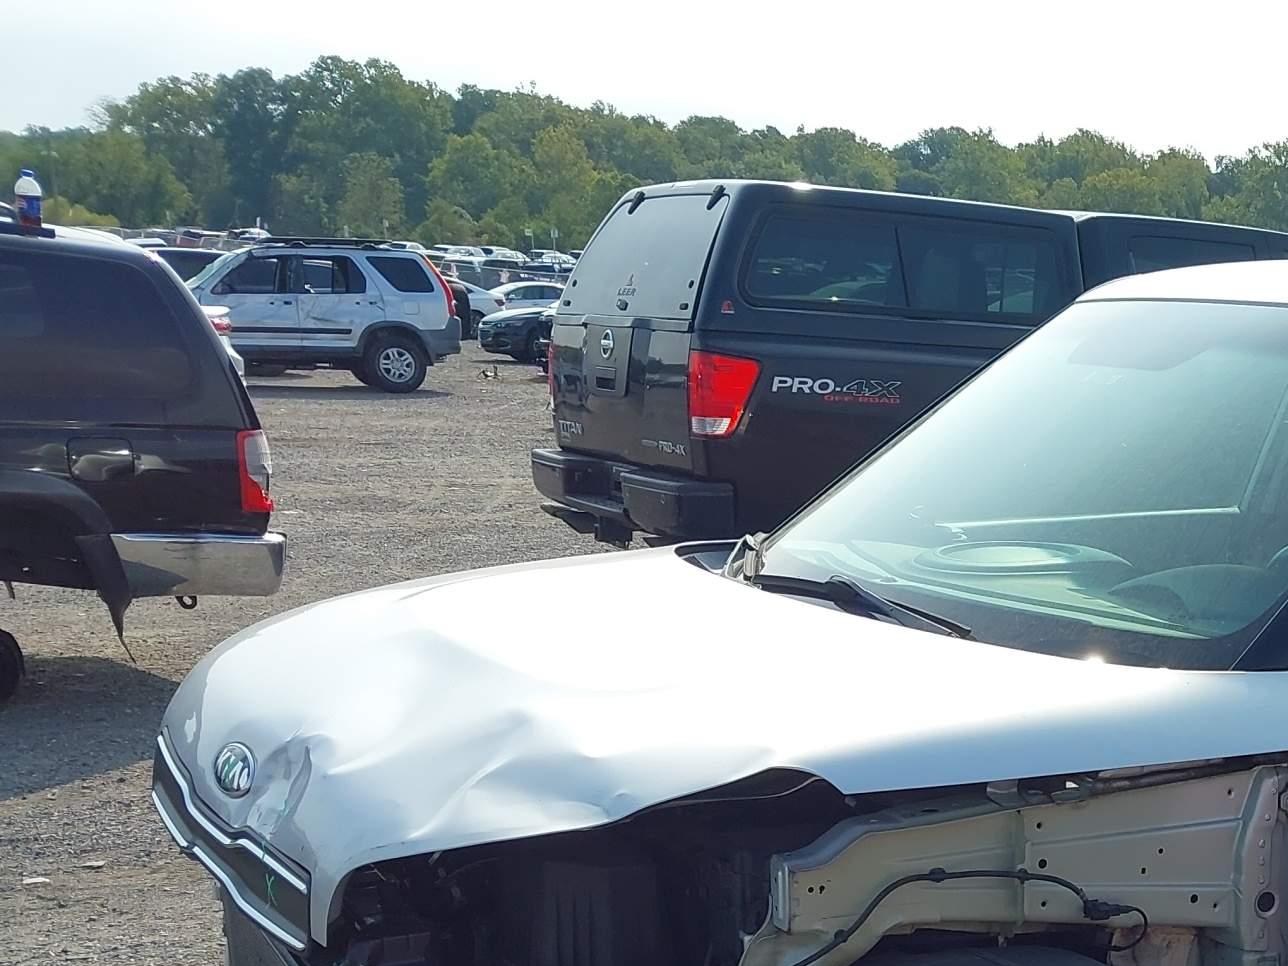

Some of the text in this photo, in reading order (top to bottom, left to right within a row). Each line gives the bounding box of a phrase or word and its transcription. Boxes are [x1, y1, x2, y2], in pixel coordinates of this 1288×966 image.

[617, 287, 637, 297] LEER
[858, 396, 901, 404] ROAD
[558, 419, 583, 435] TITAN
